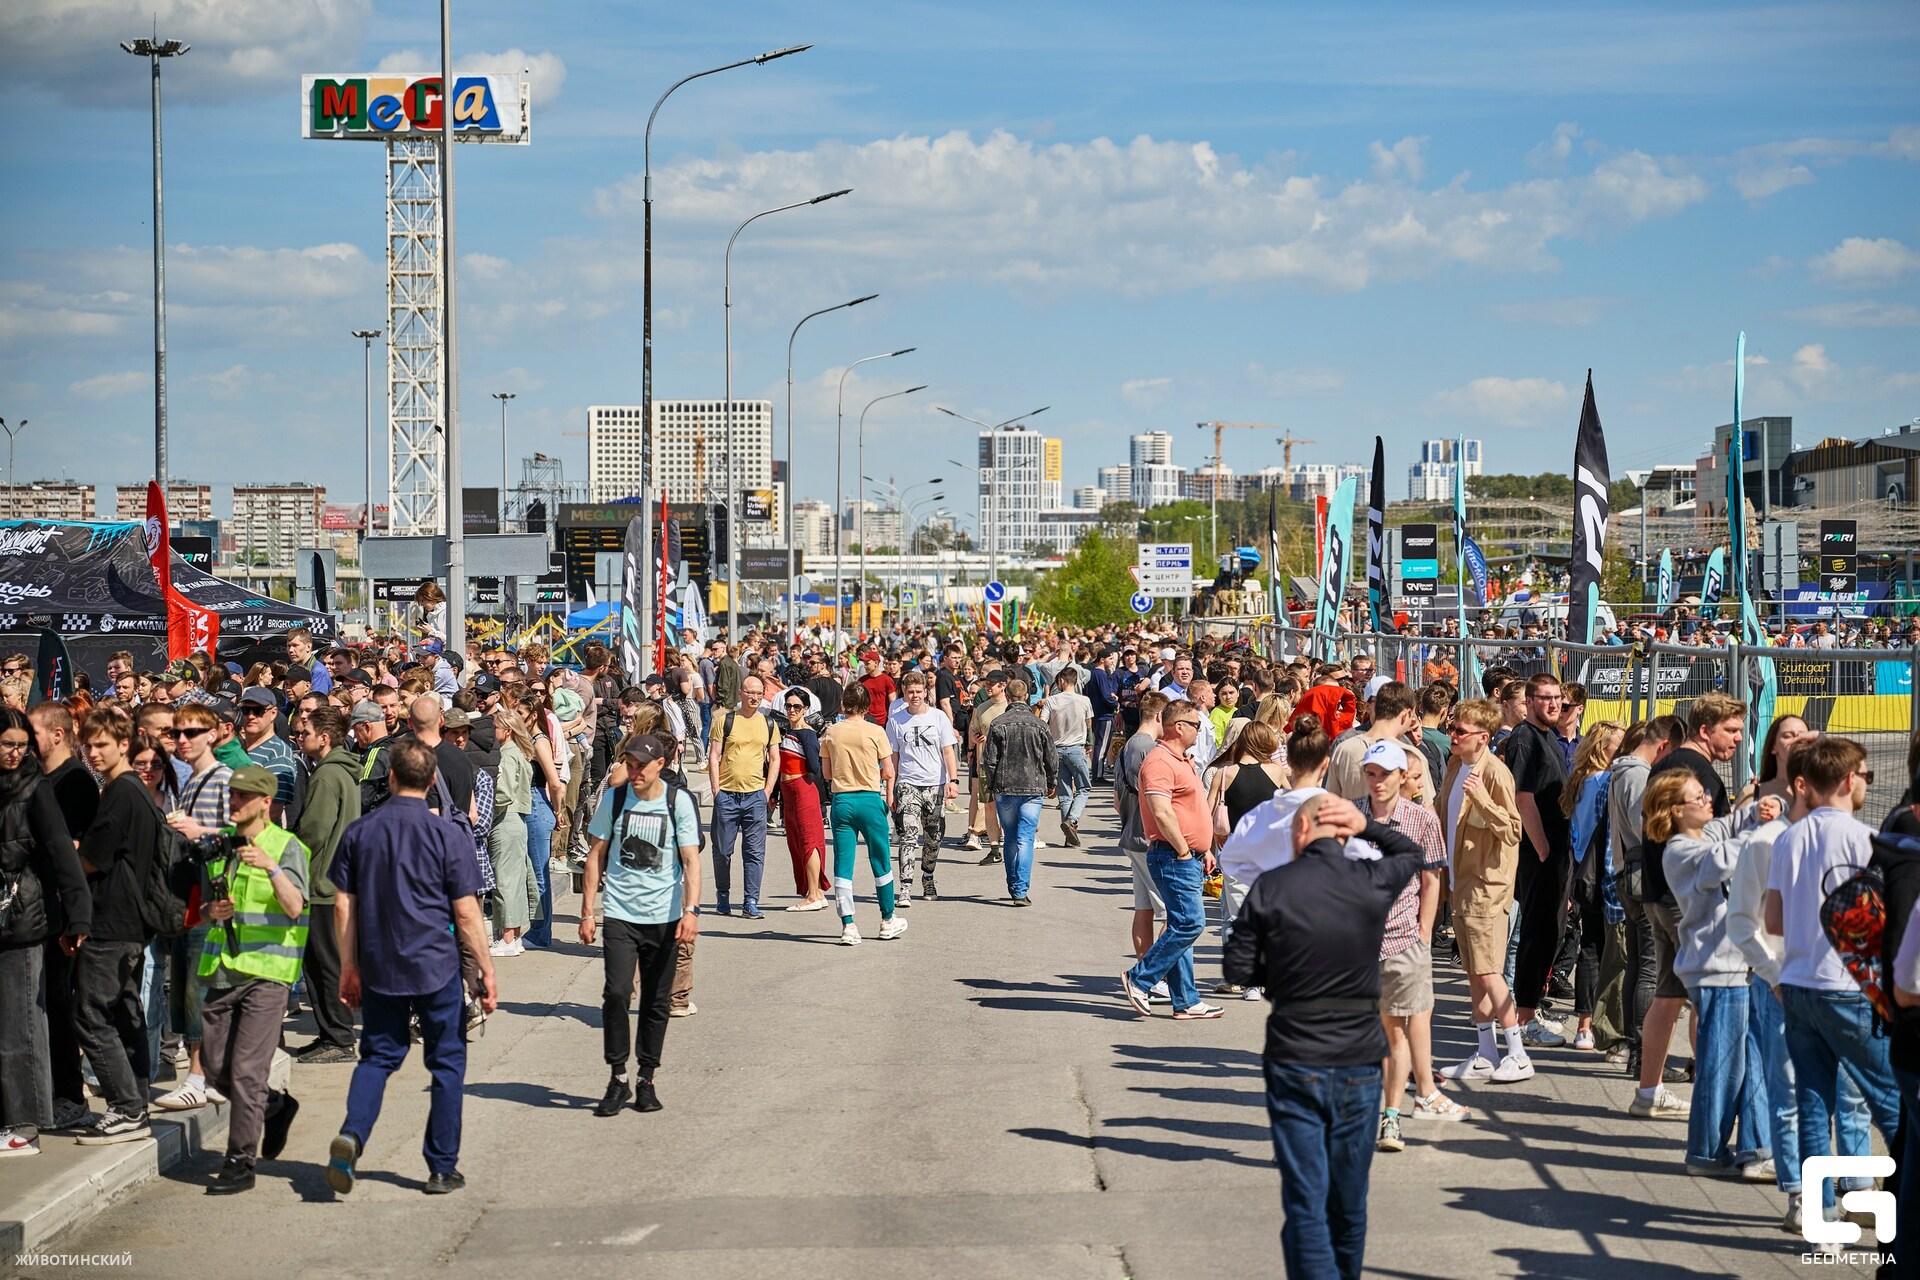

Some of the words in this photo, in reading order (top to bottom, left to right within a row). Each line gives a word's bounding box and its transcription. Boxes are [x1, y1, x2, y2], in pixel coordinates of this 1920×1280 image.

[571, 509, 616, 521] MEGA
[1824, 534, 1854, 542] PARI
[1779, 662, 1831, 675] Stuttgart
[1784, 675, 1825, 686] Detailing
